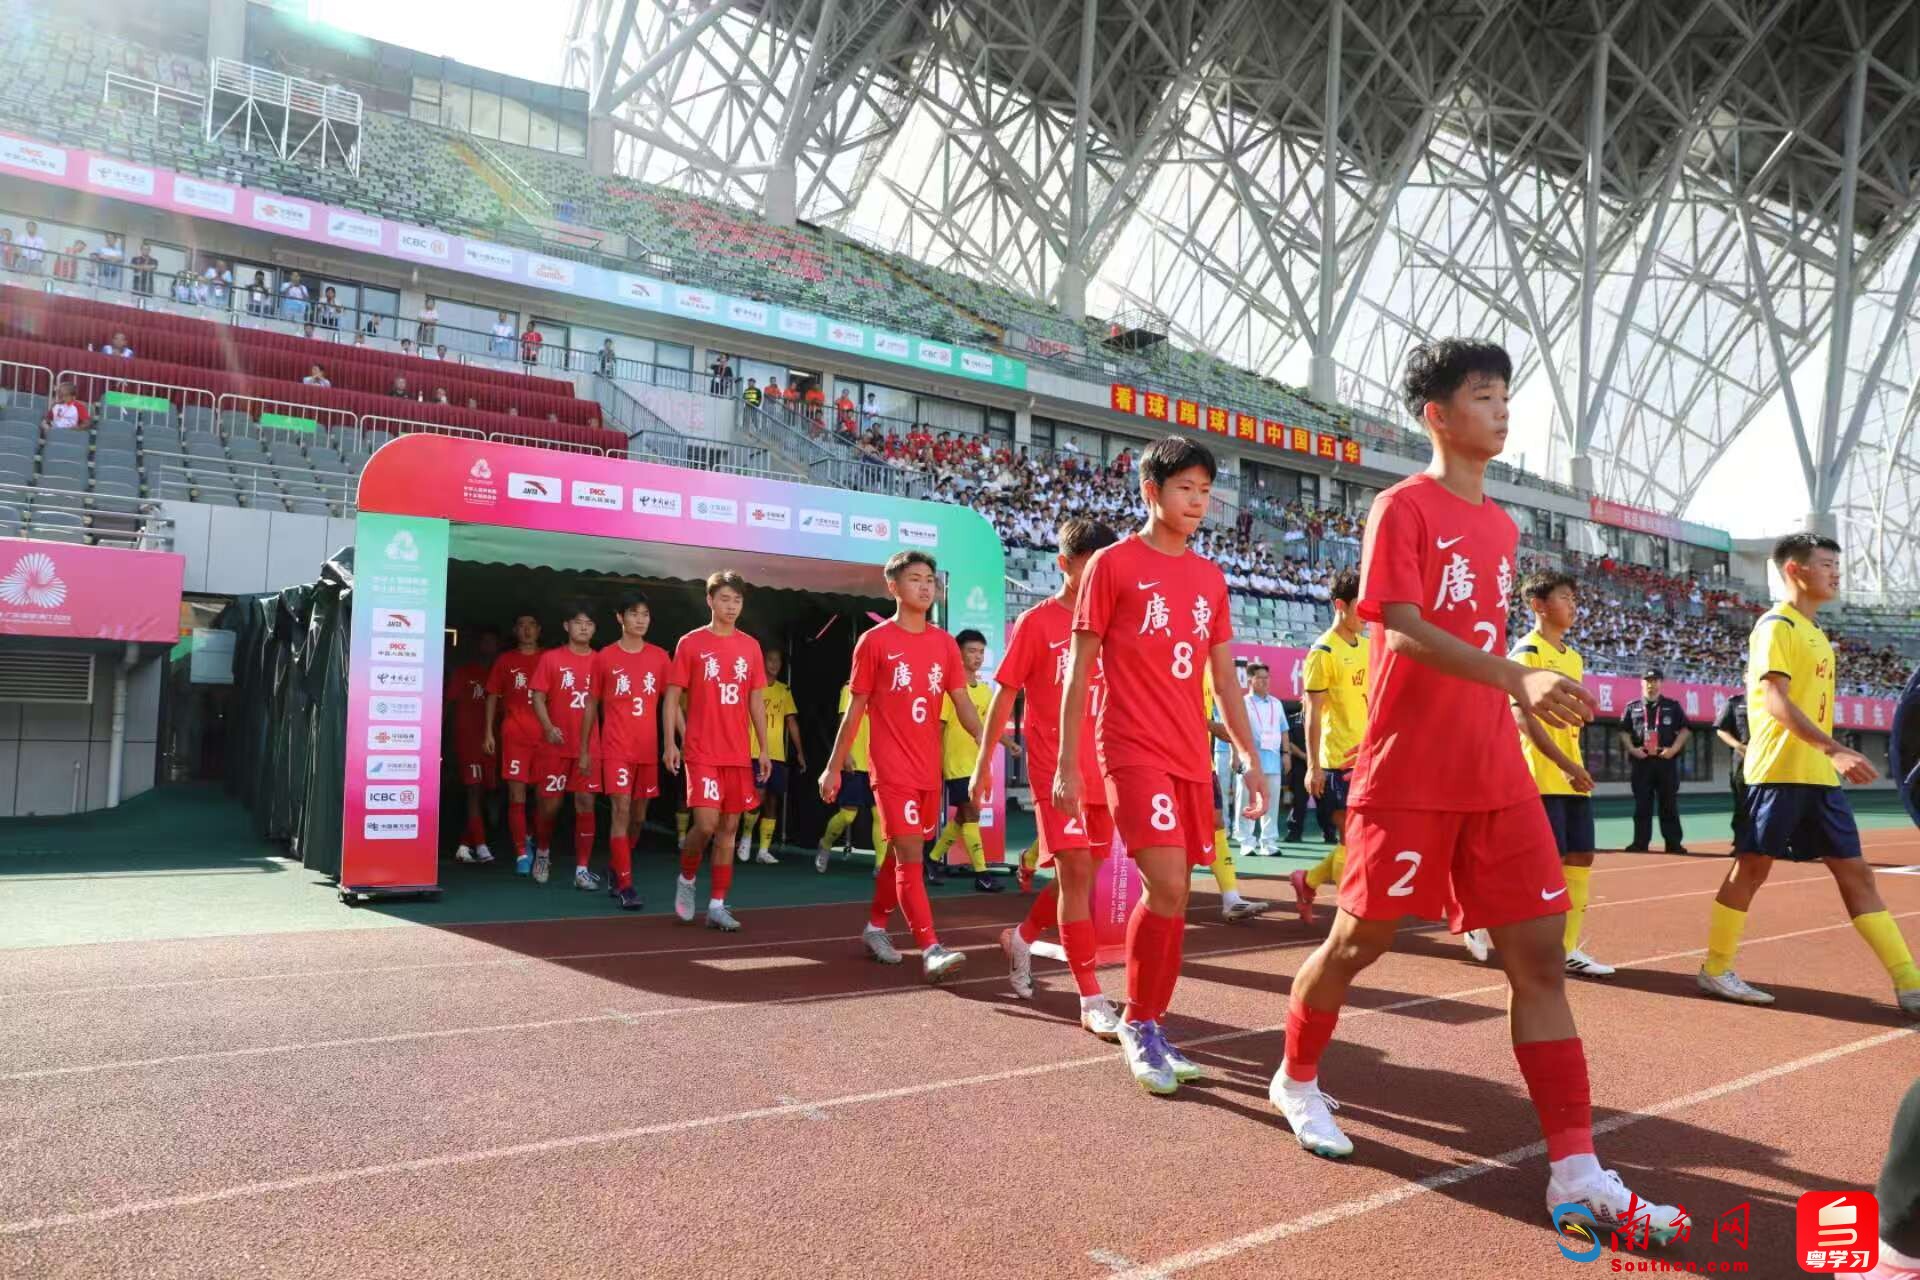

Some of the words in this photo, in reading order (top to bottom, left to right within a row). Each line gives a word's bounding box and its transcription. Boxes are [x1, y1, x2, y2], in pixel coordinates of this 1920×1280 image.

[403, 236, 427, 249] ICBC
[1114, 387, 1360, 463] 看球踢球到中国五华
[853, 522, 873, 533] ICBC
[1139, 593, 1212, 640] 廣東
[704, 656, 748, 682] 廣東
[1171, 641, 1193, 679] 8
[614, 671, 656, 696] 廣東
[890, 661, 944, 696] 廣東
[631, 697, 644, 716] 3
[719, 683, 739, 705] 18
[911, 697, 928, 723] 6
[510, 759, 520, 775] 5
[616, 768, 629, 788] 3
[546, 774, 566, 792] 20
[701, 777, 720, 801] 18
[370, 793, 397, 802] ICBC
[904, 800, 920, 825] 6
[1151, 793, 1177, 831] 8
[1387, 850, 1422, 896] 2
